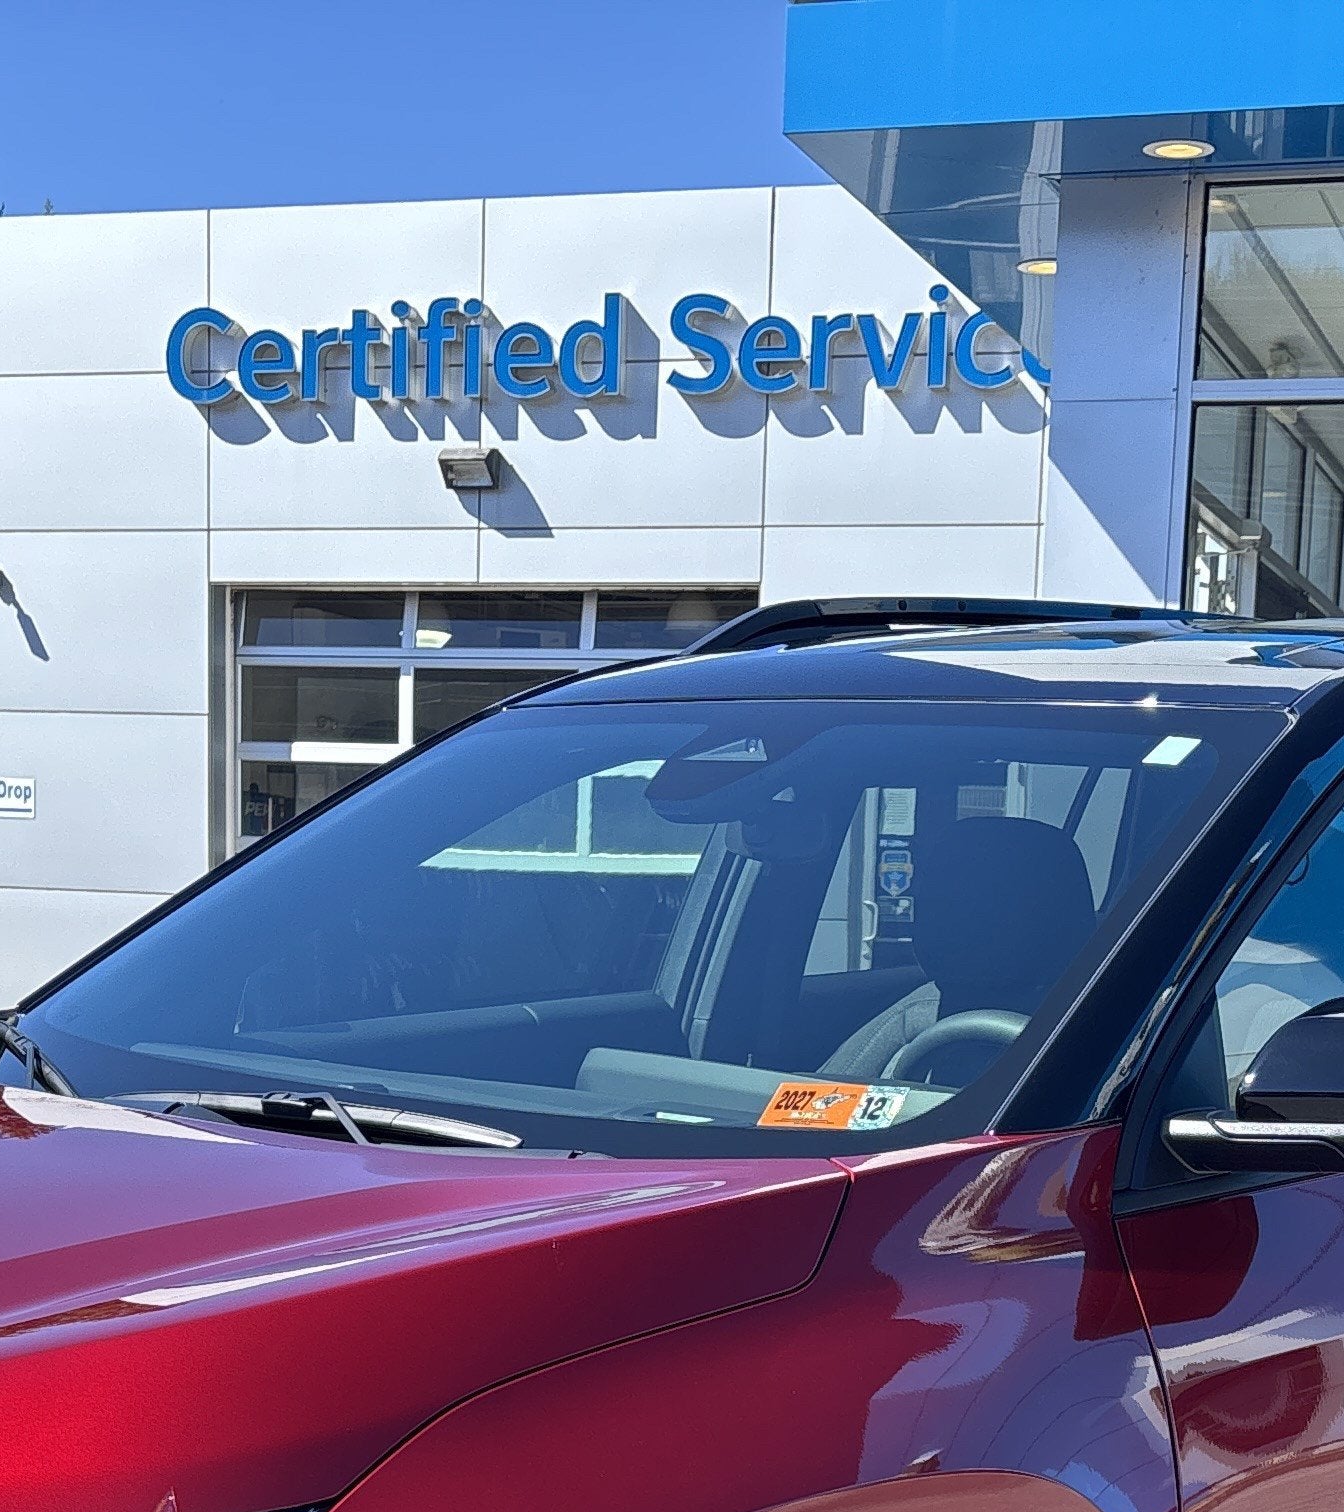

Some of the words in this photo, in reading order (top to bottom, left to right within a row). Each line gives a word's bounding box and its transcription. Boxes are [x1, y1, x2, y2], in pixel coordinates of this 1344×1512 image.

[166, 292, 623, 405] Certified
[667, 283, 1052, 397] Servic
[773, 1090, 817, 1111] 2027
[859, 1096, 888, 1121] 12
